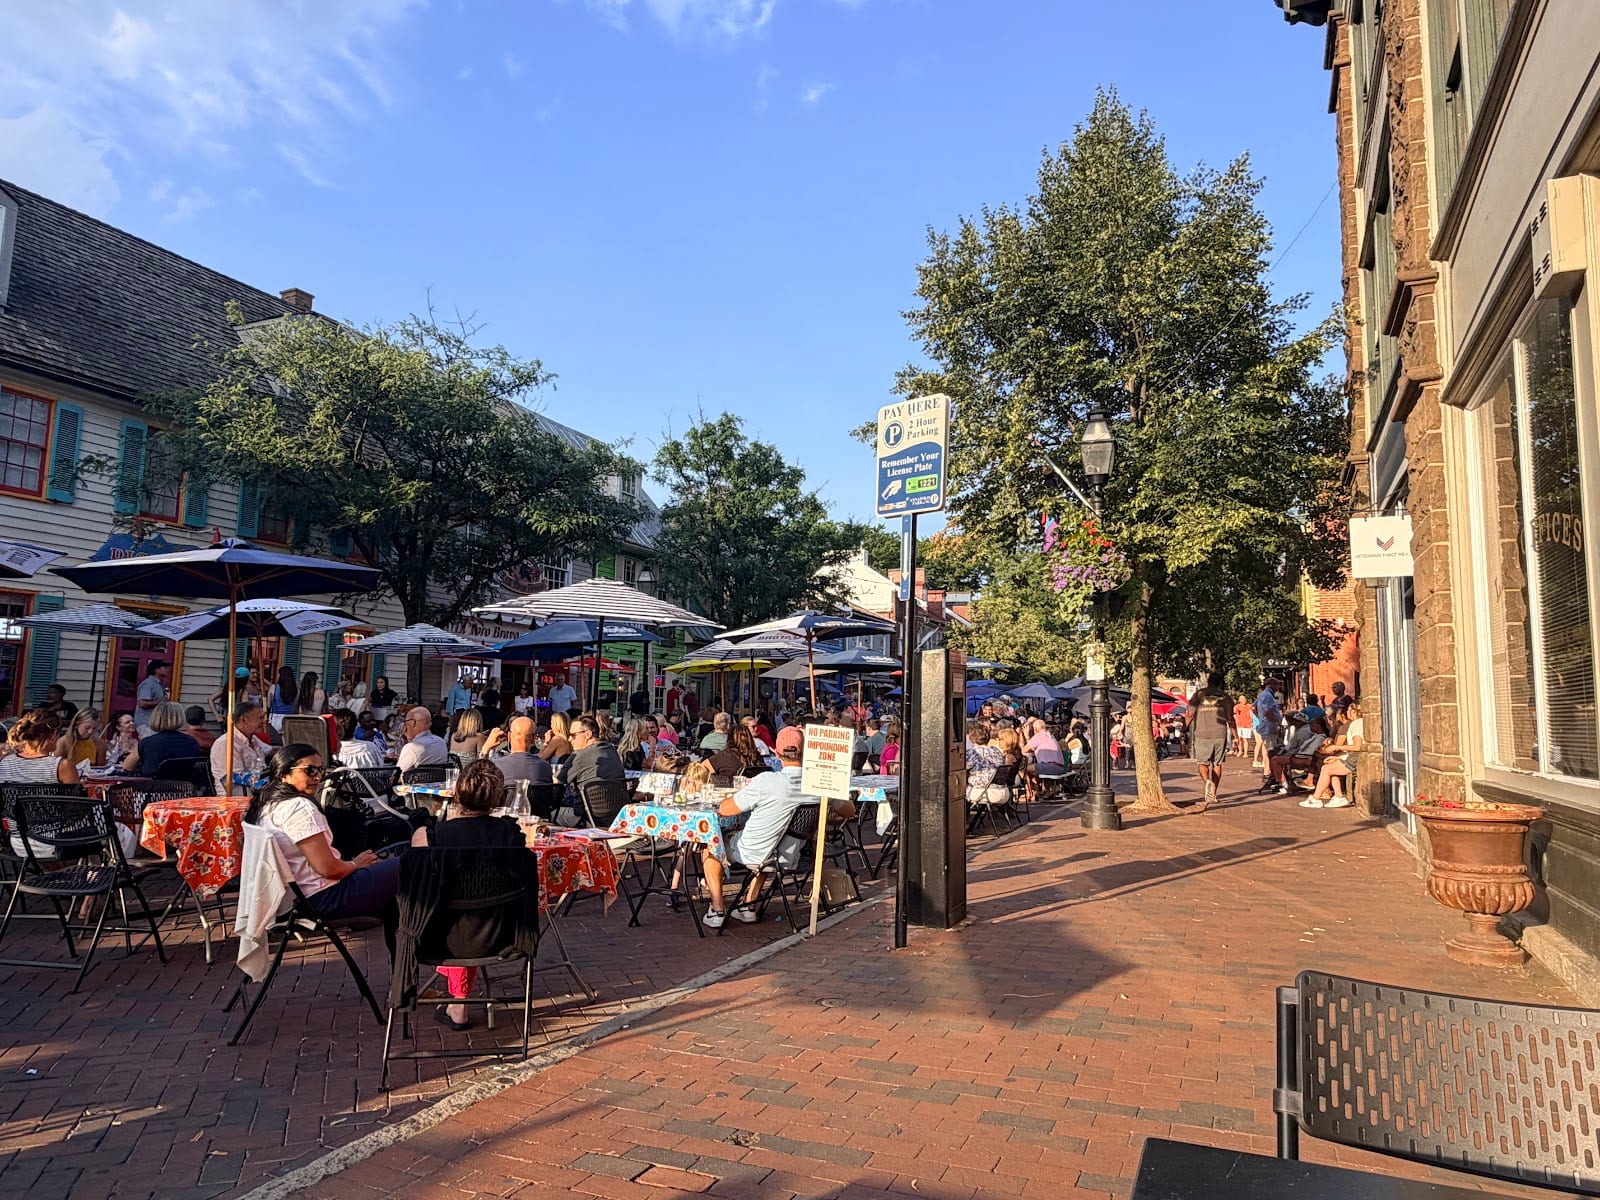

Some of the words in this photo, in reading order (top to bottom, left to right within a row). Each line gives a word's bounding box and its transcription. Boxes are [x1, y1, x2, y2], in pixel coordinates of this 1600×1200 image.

[884, 405, 903, 420] PAY
[908, 398, 940, 415] HERE
[909, 420, 913, 428] 2
[916, 417, 937, 426] Hour
[907, 427, 938, 439] Parking
[882, 455, 918, 468] Remember
[920, 452, 939, 460] Your
[887, 466, 912, 477] License
[914, 463, 932, 473] Plate
[808, 727, 819, 737] NO
[819, 728, 850, 740] PARKING
[807, 740, 848, 753] IMPOUNDING
[818, 752, 835, 761] ZONE
